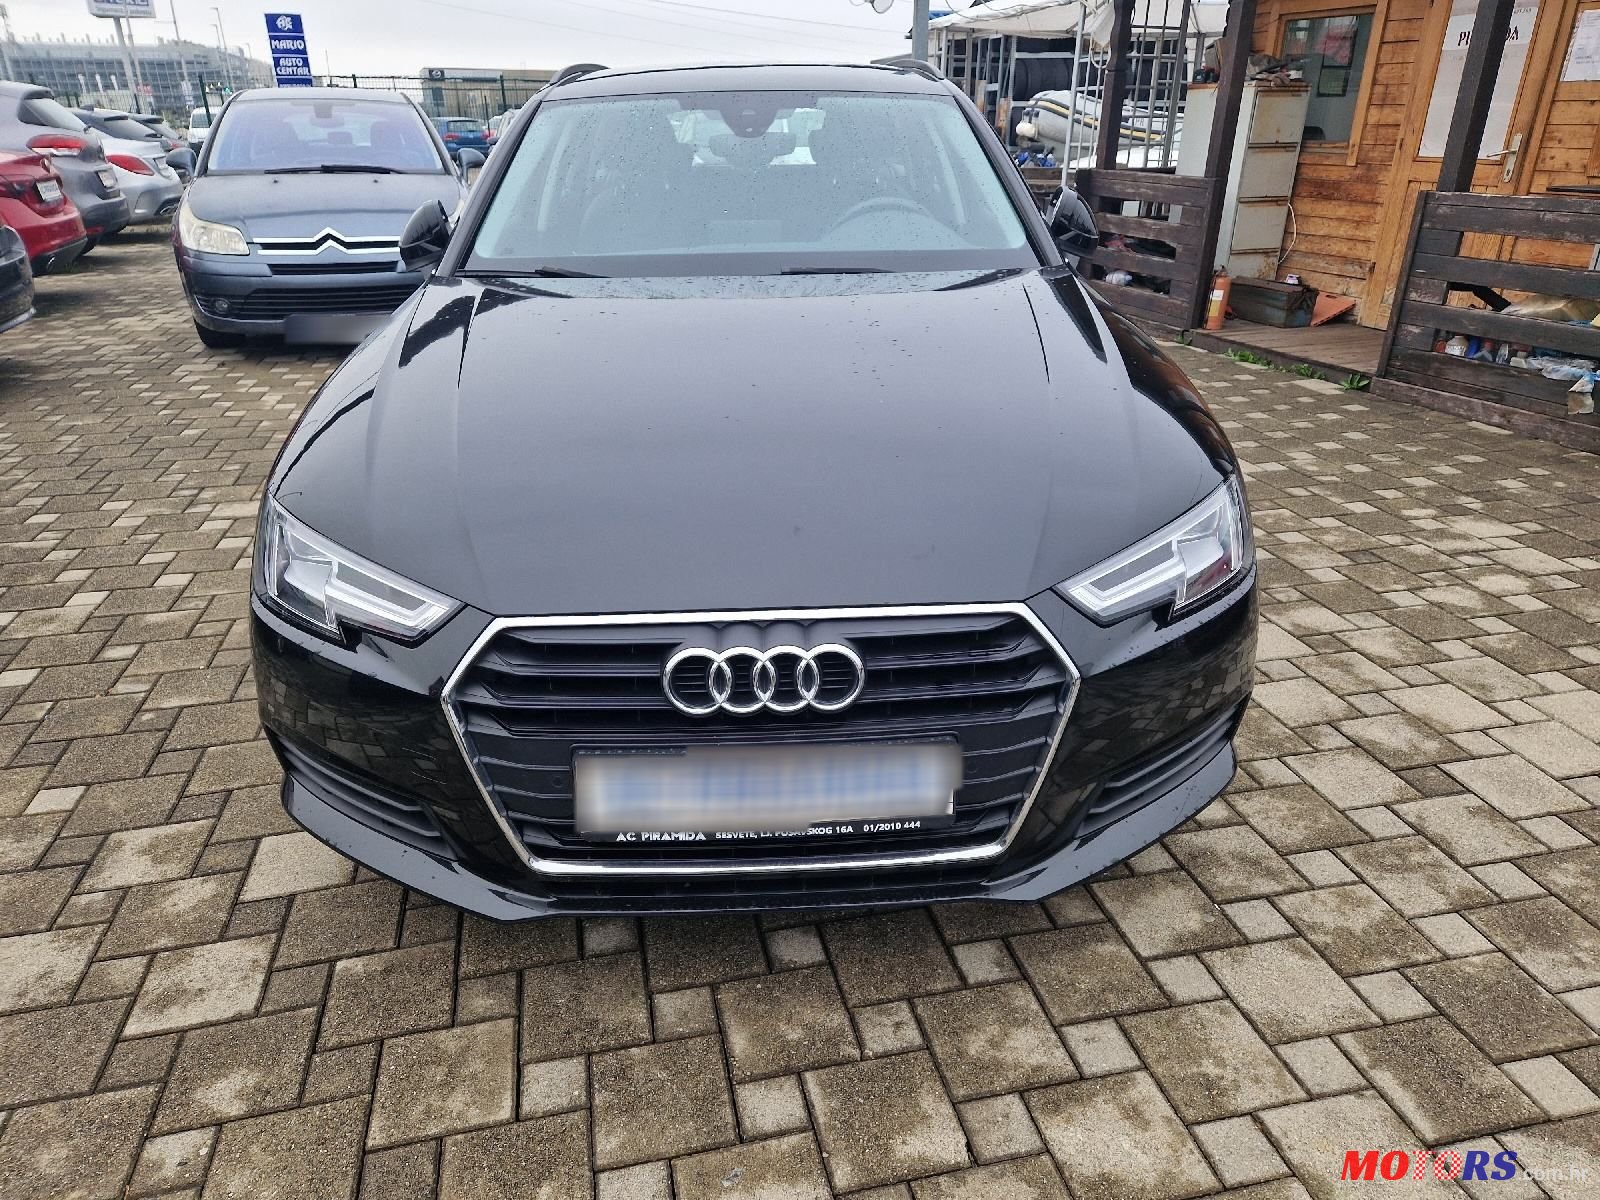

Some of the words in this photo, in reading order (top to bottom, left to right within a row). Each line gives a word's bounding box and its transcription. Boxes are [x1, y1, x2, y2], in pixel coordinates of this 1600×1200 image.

[1457, 25, 1520, 47] PIDA
[272, 40, 304, 50] MARIO
[280, 57, 303, 67] AUTO
[276, 66, 310, 76] CENTAR
[616, 831, 637, 842] AC
[641, 831, 707, 841] PIRAMIDA
[836, 825, 854, 834] 16A
[863, 822, 901, 833] 01/2010
[903, 820, 921, 829] 444
